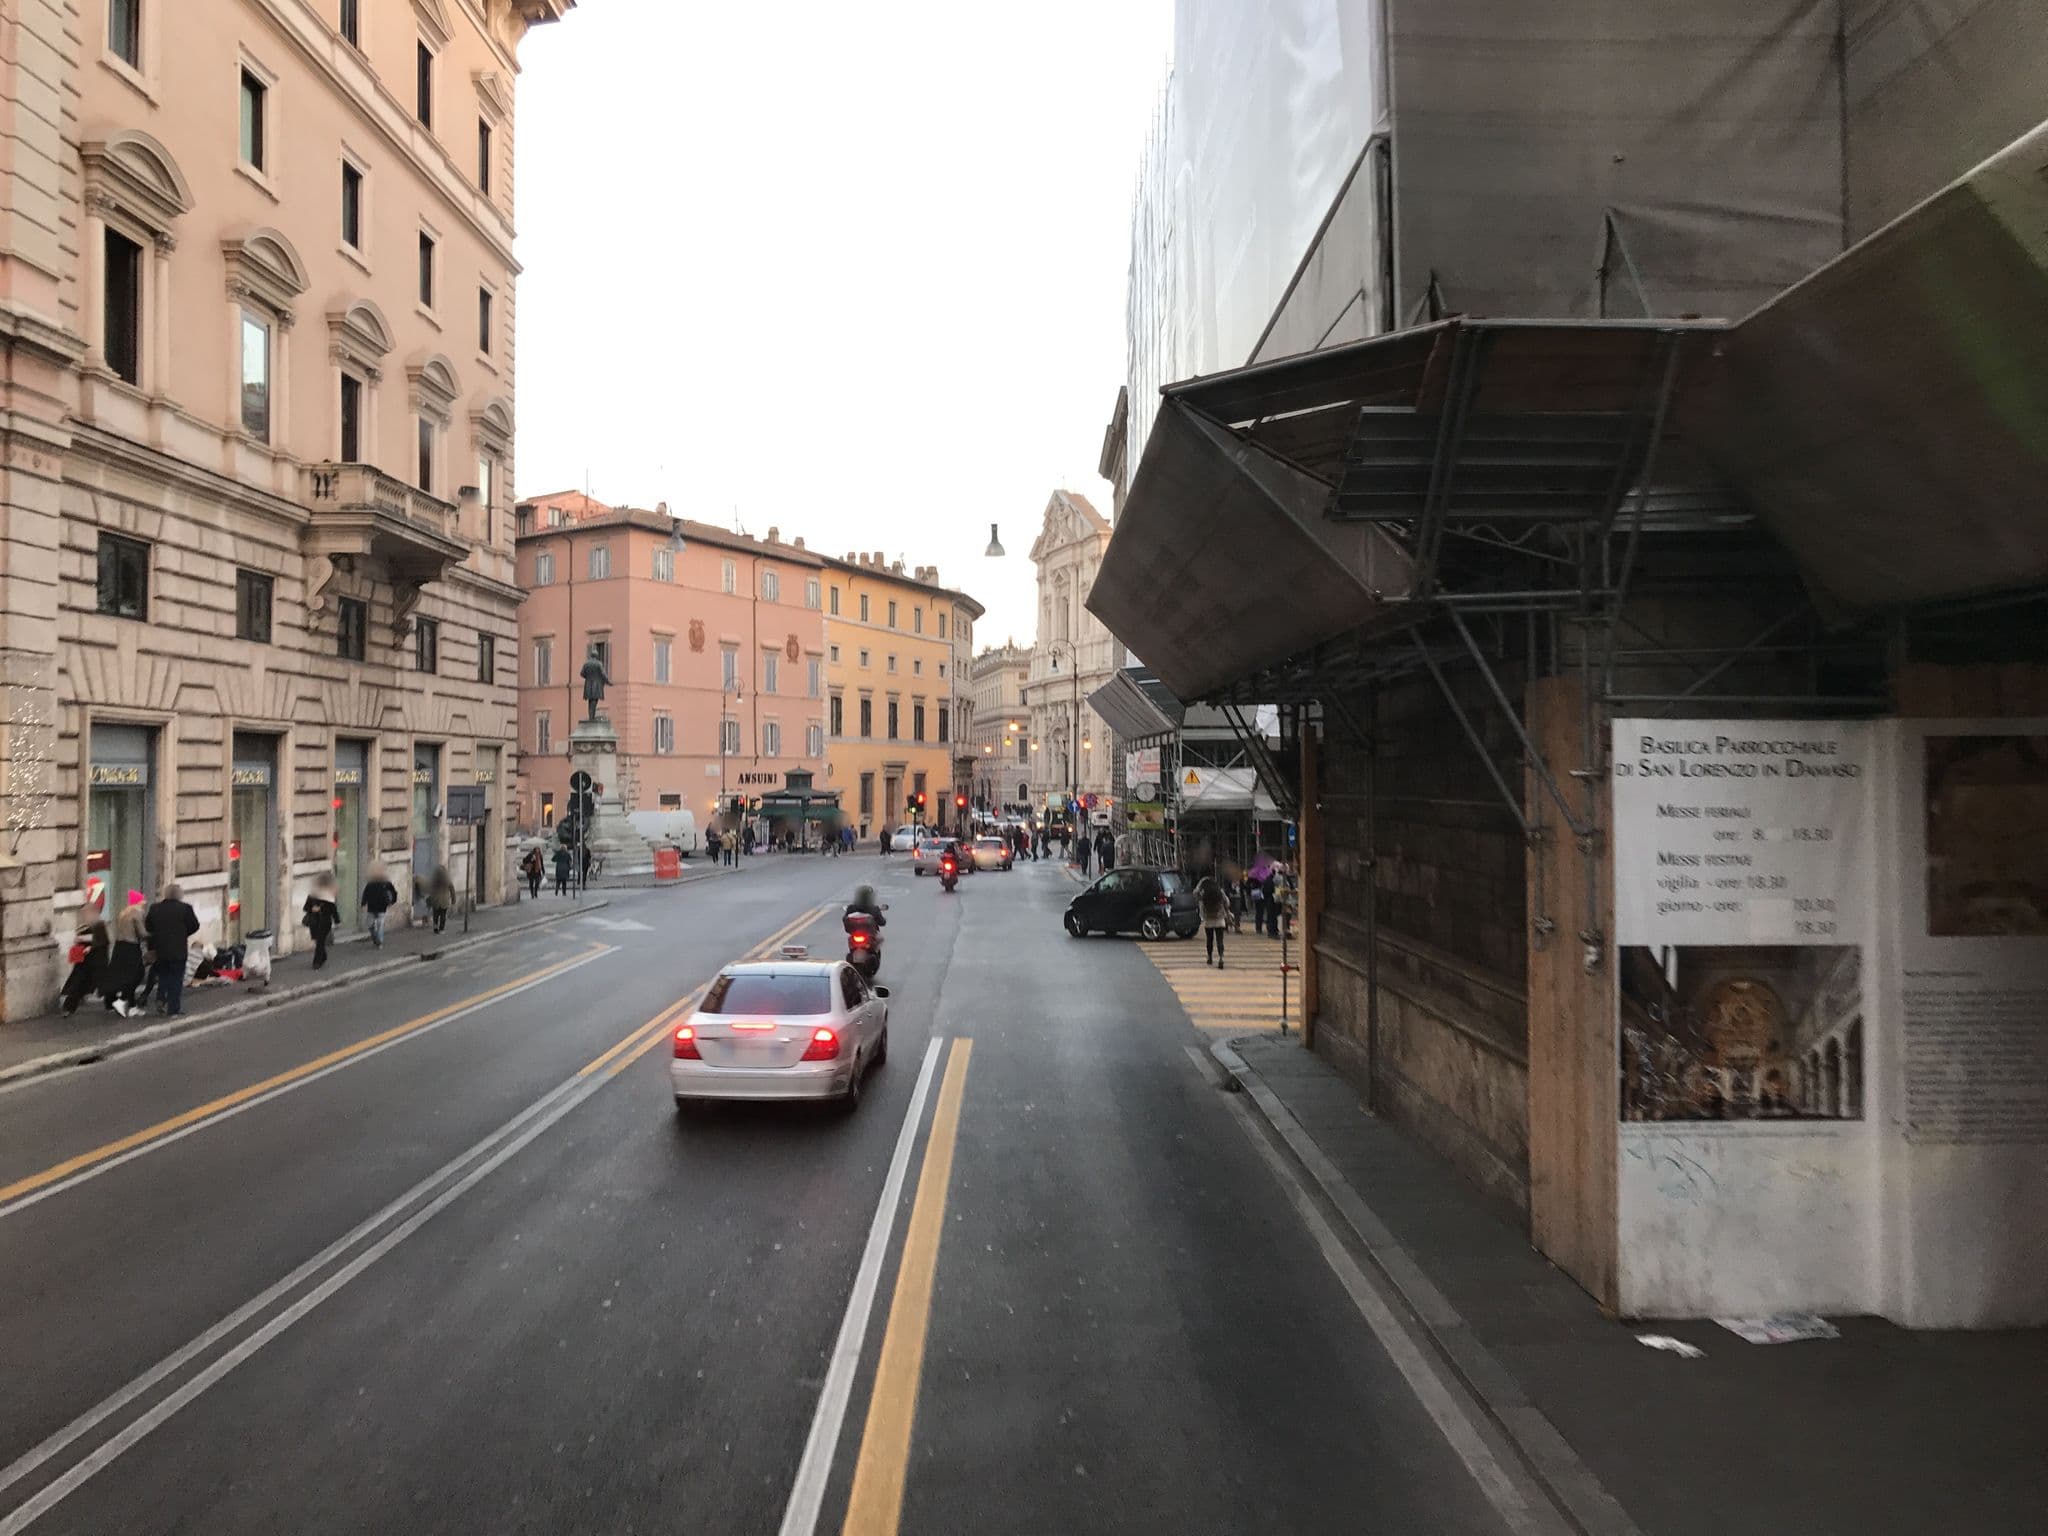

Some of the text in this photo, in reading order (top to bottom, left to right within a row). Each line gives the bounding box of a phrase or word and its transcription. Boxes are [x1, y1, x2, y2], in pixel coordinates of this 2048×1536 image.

[1640, 736, 1711, 754] BASILICA
[1638, 759, 1674, 777] SAN
[1679, 759, 1758, 778] LORENZO
[738, 772, 777, 784] ANSUINI
